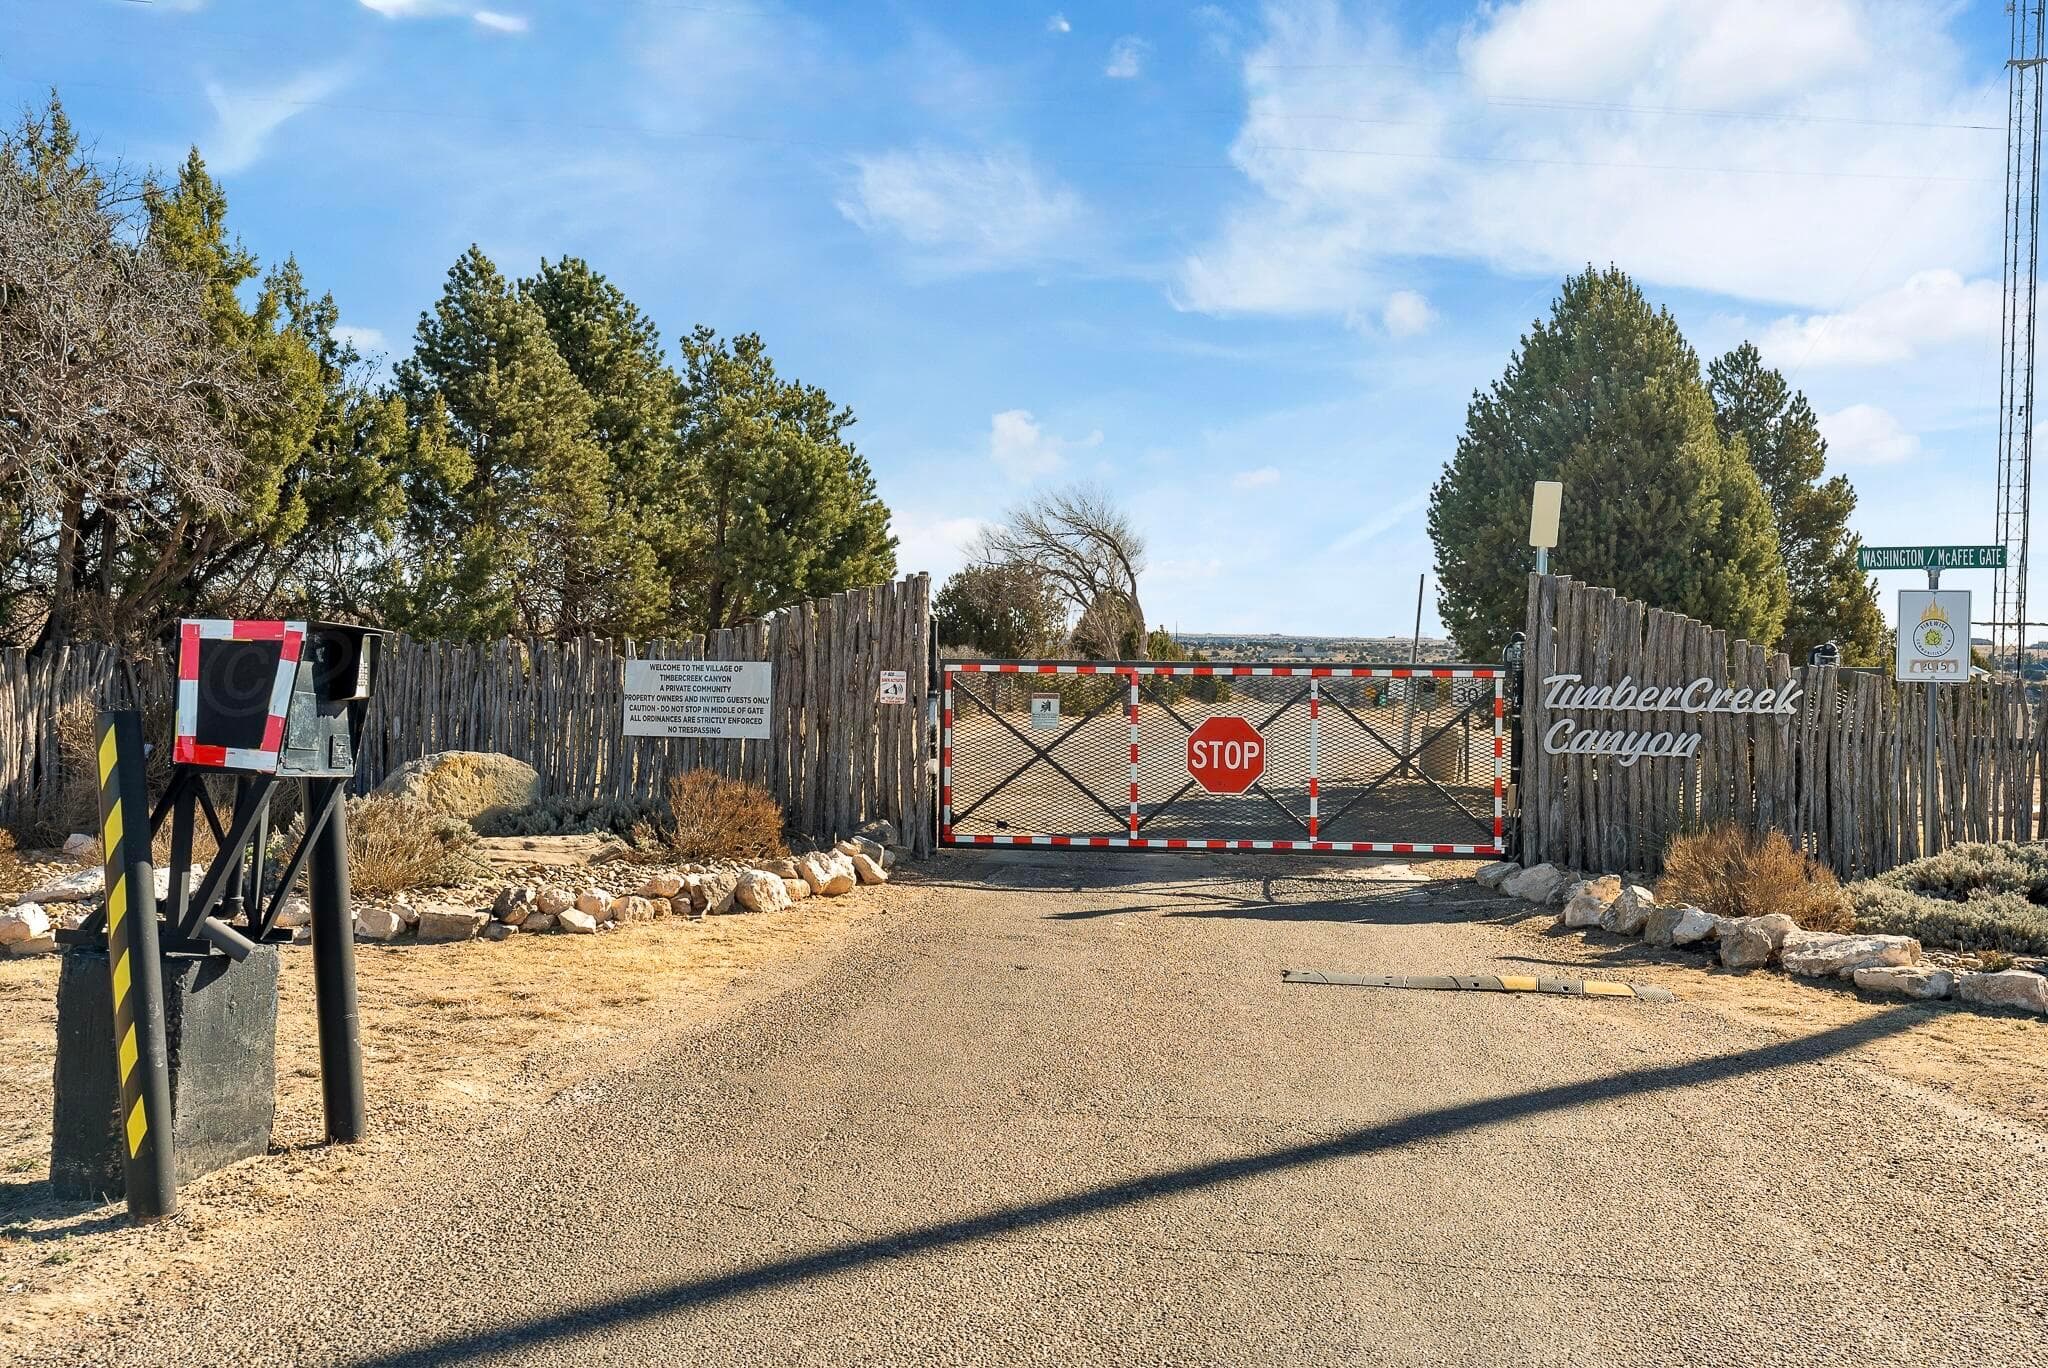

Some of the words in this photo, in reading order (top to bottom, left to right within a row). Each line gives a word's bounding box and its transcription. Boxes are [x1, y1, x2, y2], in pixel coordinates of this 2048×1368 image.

[1862, 549, 1924, 567] WASHINGTON
[1938, 549, 1974, 566] McAFEE
[1980, 548, 2002, 566] GATE
[649, 663, 681, 671] WELCOME
[691, 664, 704, 672] THE
[734, 665, 743, 673] OF
[660, 674, 703, 682] TIMBERCREEK
[704, 675, 732, 683] CANYON
[660, 684, 664, 692] A
[665, 684, 691, 692] PRIVATE
[692, 685, 731, 693] COMMUNITY
[624, 694, 655, 702] PROPERTY
[656, 694, 683, 702] OWNERS
[684, 695, 698, 703] AND
[726, 696, 752, 704] GUESTS
[1456, 687, 1479, 702] 30
[1543, 673, 1804, 716] TimberCreek
[629, 704, 656, 712] CAUTION
[671, 705, 684, 713] NOT
[685, 705, 702, 713] STOP
[711, 706, 736, 714] MIDDLE
[630, 714, 641, 722] ALL
[642, 715, 682, 723] ORDINANCES
[696, 716, 727, 724] STRICTLY
[728, 717, 763, 725] ENFORCED
[678, 726, 721, 734] TRESPASSING
[1543, 718, 1702, 767] Canyon
[1191, 740, 1260, 770] STOP
